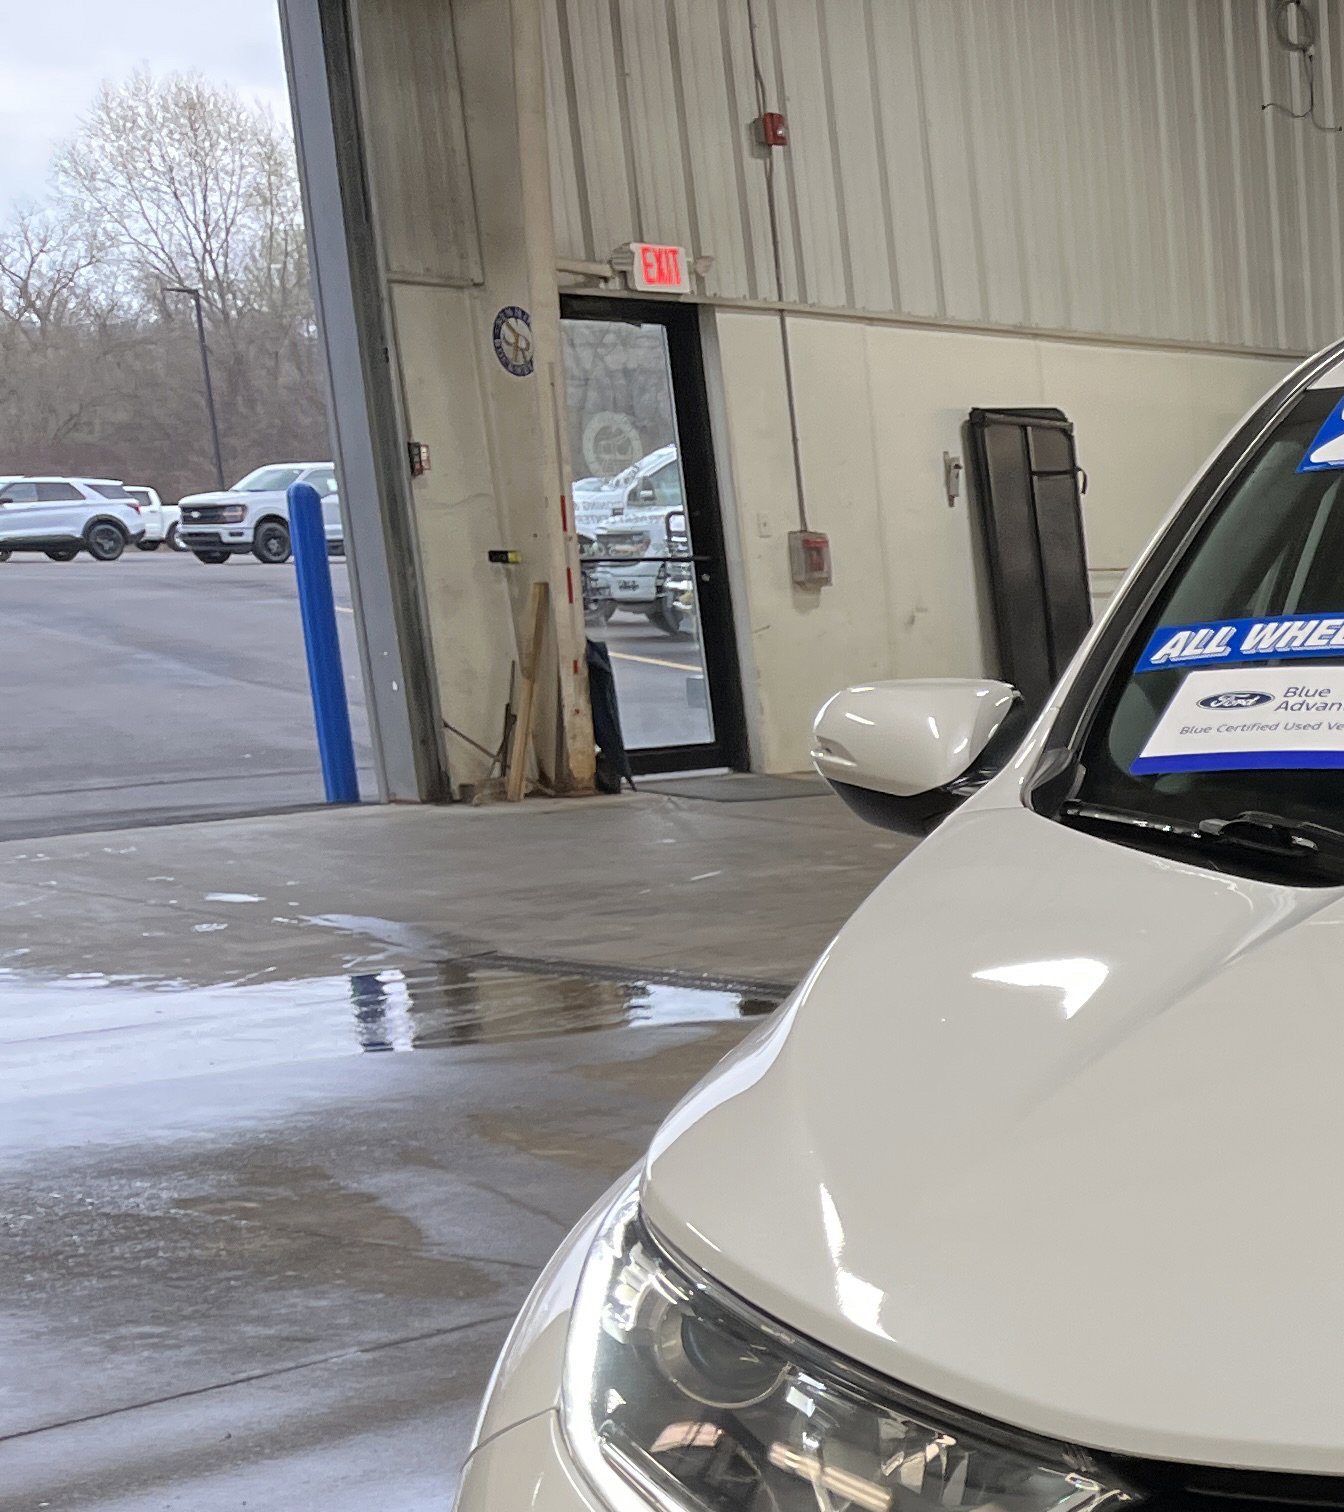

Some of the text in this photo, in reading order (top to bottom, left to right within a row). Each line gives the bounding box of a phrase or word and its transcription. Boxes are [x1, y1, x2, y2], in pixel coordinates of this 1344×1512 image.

[641, 246, 681, 286] EXIT
[1151, 626, 1236, 664] ALL
[1283, 685, 1331, 698] Blue
[1179, 725, 1213, 736] Blue
[1216, 722, 1280, 734] Certified
[1284, 721, 1323, 732] Used
